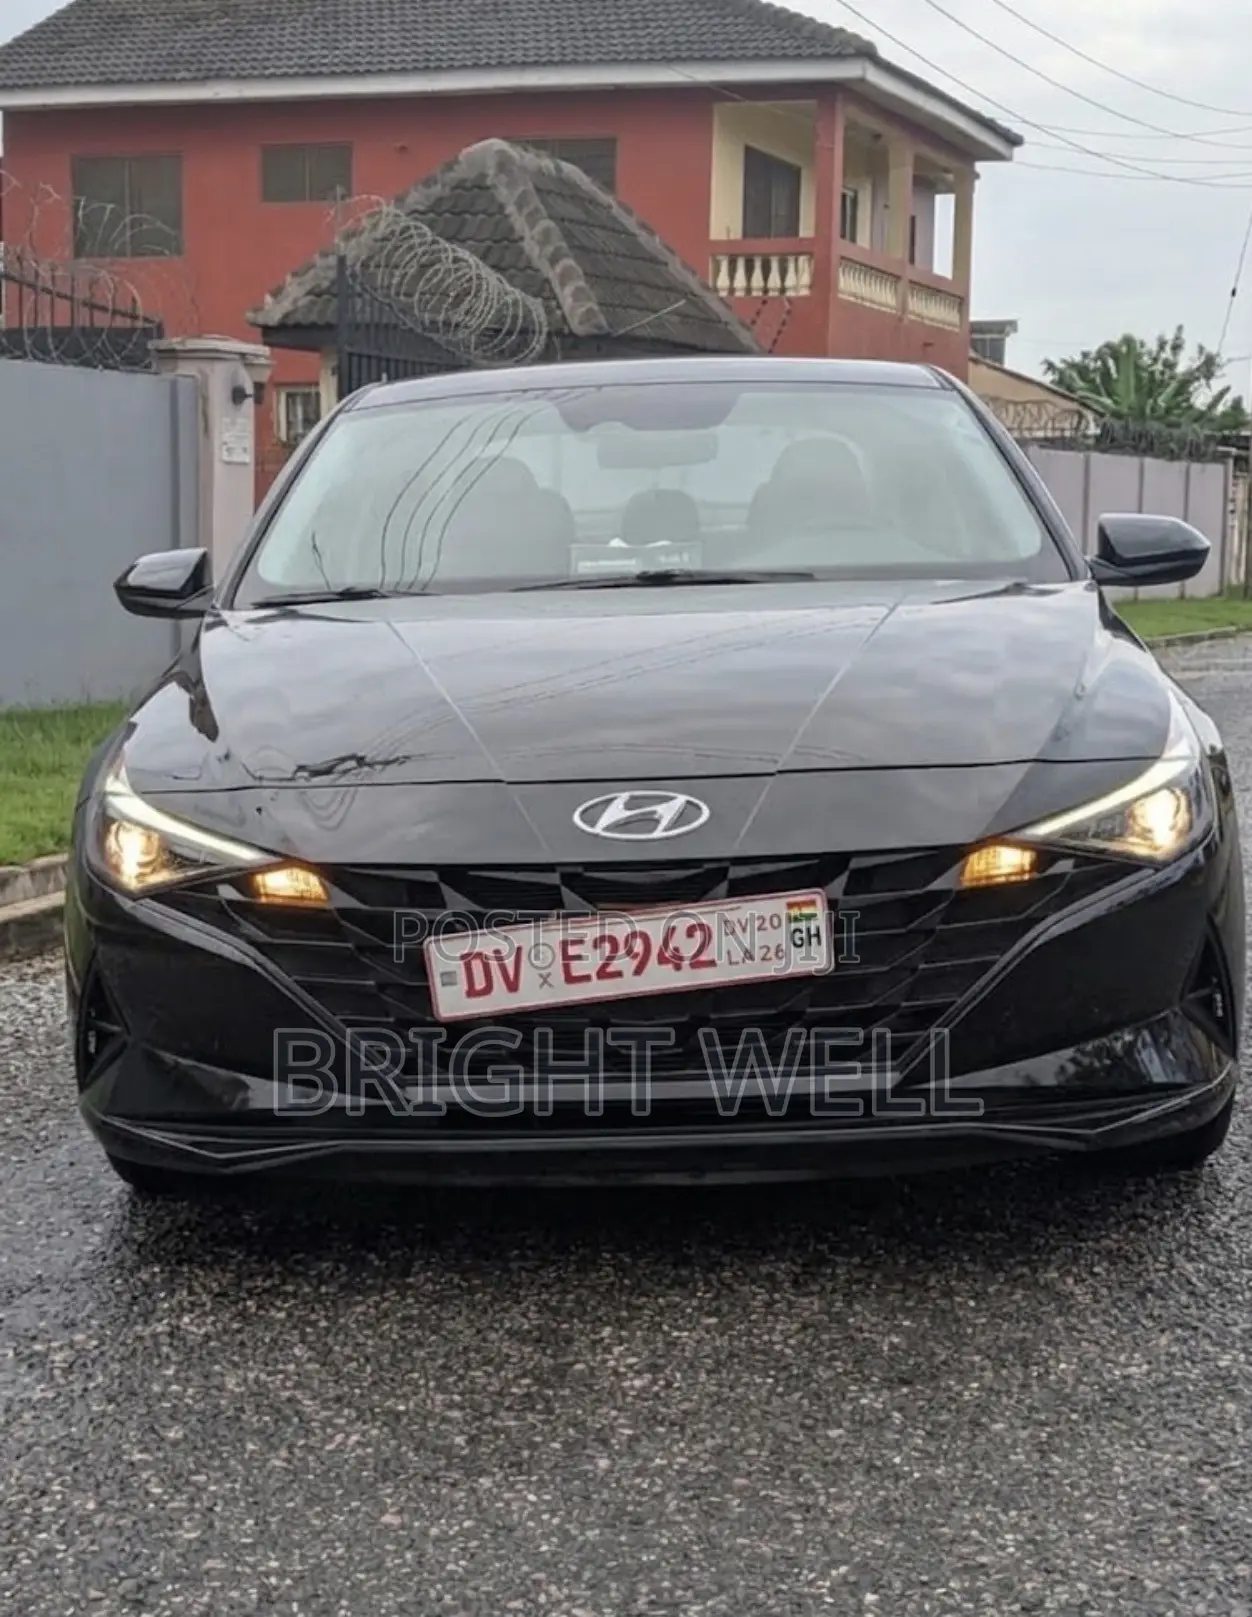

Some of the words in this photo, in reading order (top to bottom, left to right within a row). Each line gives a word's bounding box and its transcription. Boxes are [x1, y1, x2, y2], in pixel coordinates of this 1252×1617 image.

[757, 913, 782, 932] 20
[792, 925, 822, 948] GH
[460, 945, 523, 998] DV
[560, 923, 717, 984] E2942
[760, 943, 786, 962] 26
